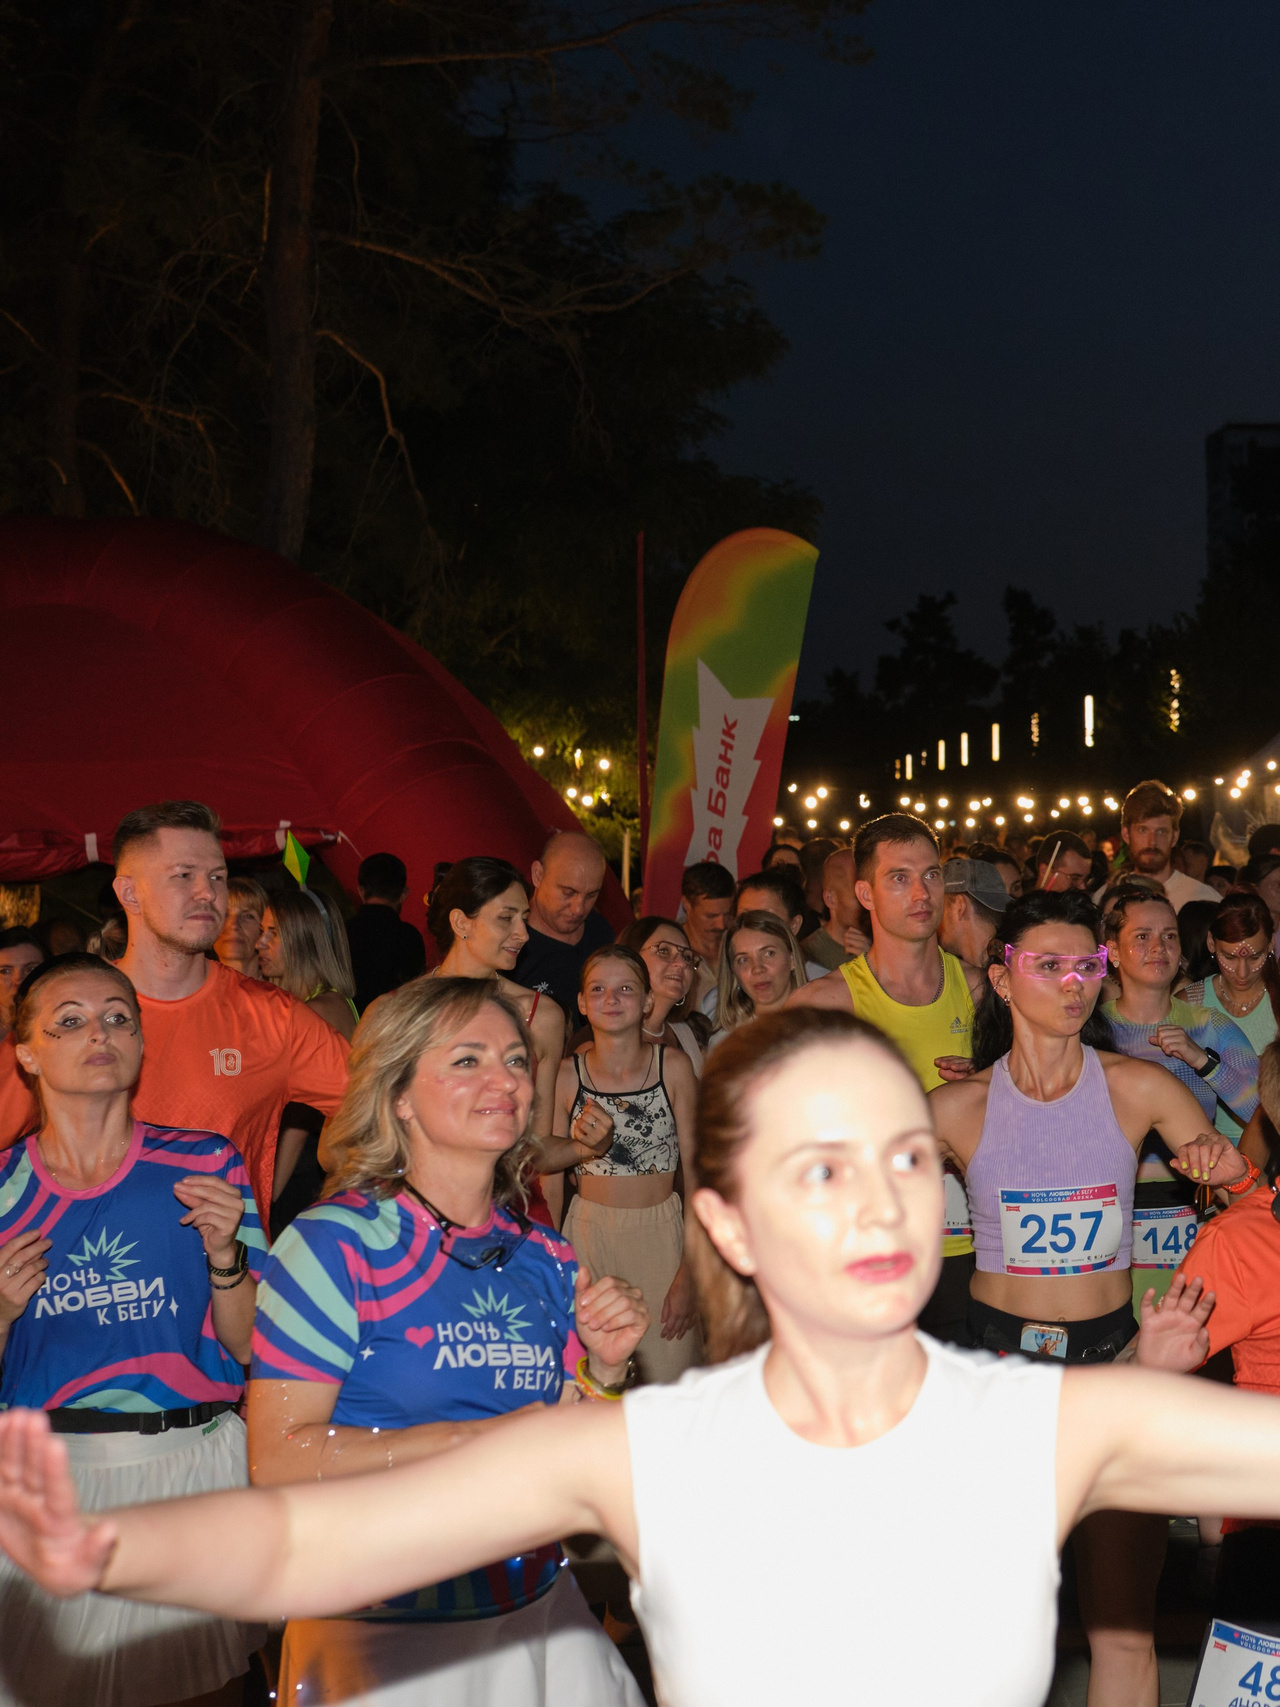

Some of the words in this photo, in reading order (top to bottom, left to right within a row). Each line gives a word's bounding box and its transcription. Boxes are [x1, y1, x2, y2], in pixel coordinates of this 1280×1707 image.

[706, 712, 738, 819] Банк
[208, 1048, 242, 1076] 10
[1020, 1210, 1103, 1254] 257
[1142, 1223, 1198, 1255] 148
[37, 1267, 101, 1296] НОЧЬ
[34, 1277, 165, 1320] ЛЮБВИ
[96, 1307, 112, 1326] К
[117, 1298, 165, 1322] БЕГУ
[436, 1321, 501, 1343] НОЧЬ
[433, 1343, 556, 1370] ЛЮБВИ
[494, 1368, 508, 1389] К
[513, 1368, 555, 1391] БЕГУ
